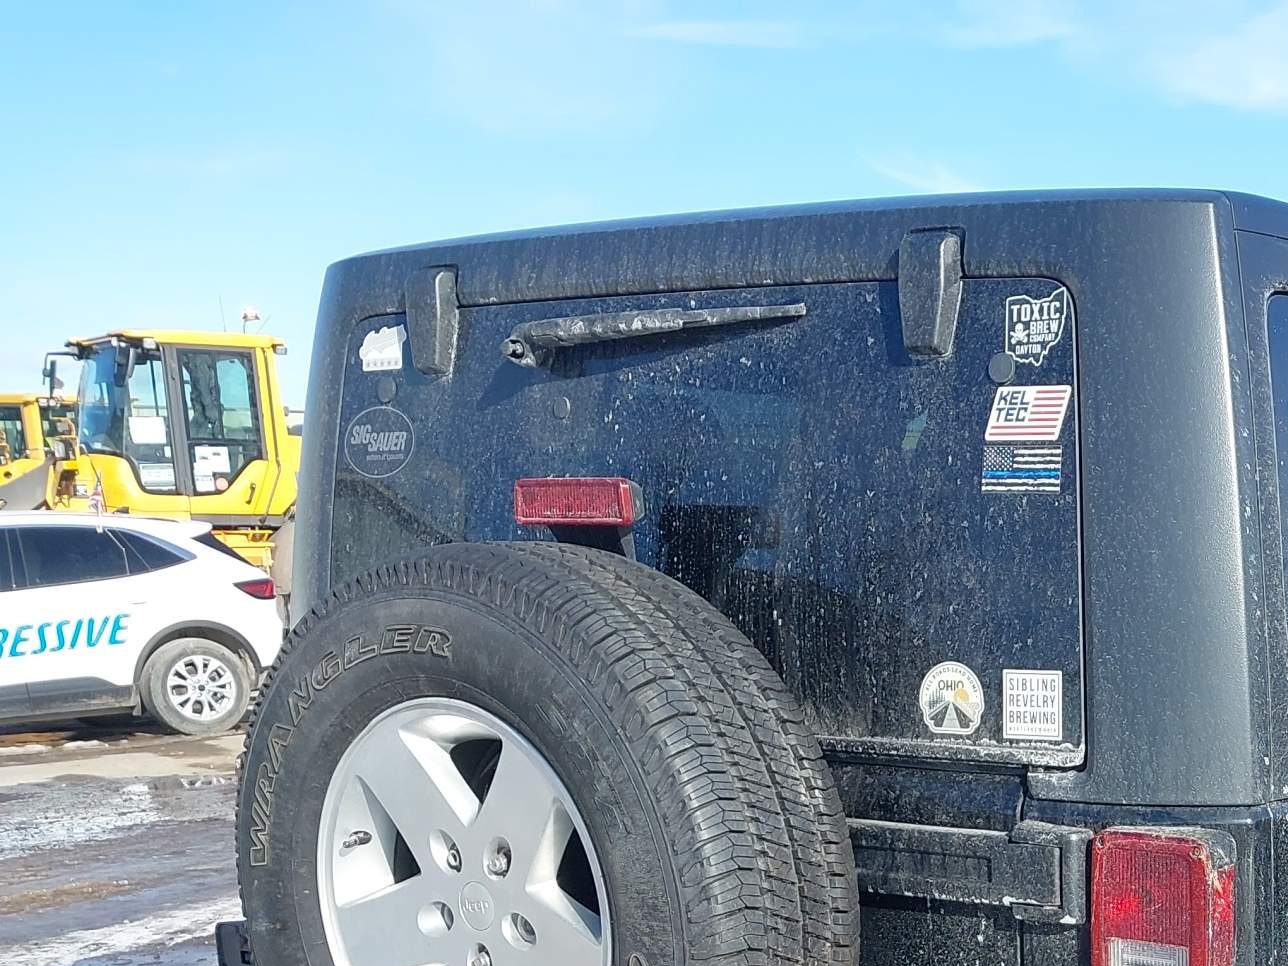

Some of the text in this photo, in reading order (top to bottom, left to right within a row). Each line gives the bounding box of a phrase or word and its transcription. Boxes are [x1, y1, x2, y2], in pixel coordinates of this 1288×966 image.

[1010, 301, 1060, 323] TOXIC
[1029, 319, 1060, 335] BREW
[1015, 343, 1042, 355] DAYTON
[997, 390, 1030, 406] KEL
[995, 406, 1029, 423] TEC
[350, 424, 407, 452] SIG SAUER
[937, 679, 965, 692] OHIO
[1008, 677, 1057, 692] SIBLING
[1008, 693, 1057, 709] REVELRY
[1008, 710, 1057, 725] BREWING
[249, 623, 453, 868] WRANGLER
